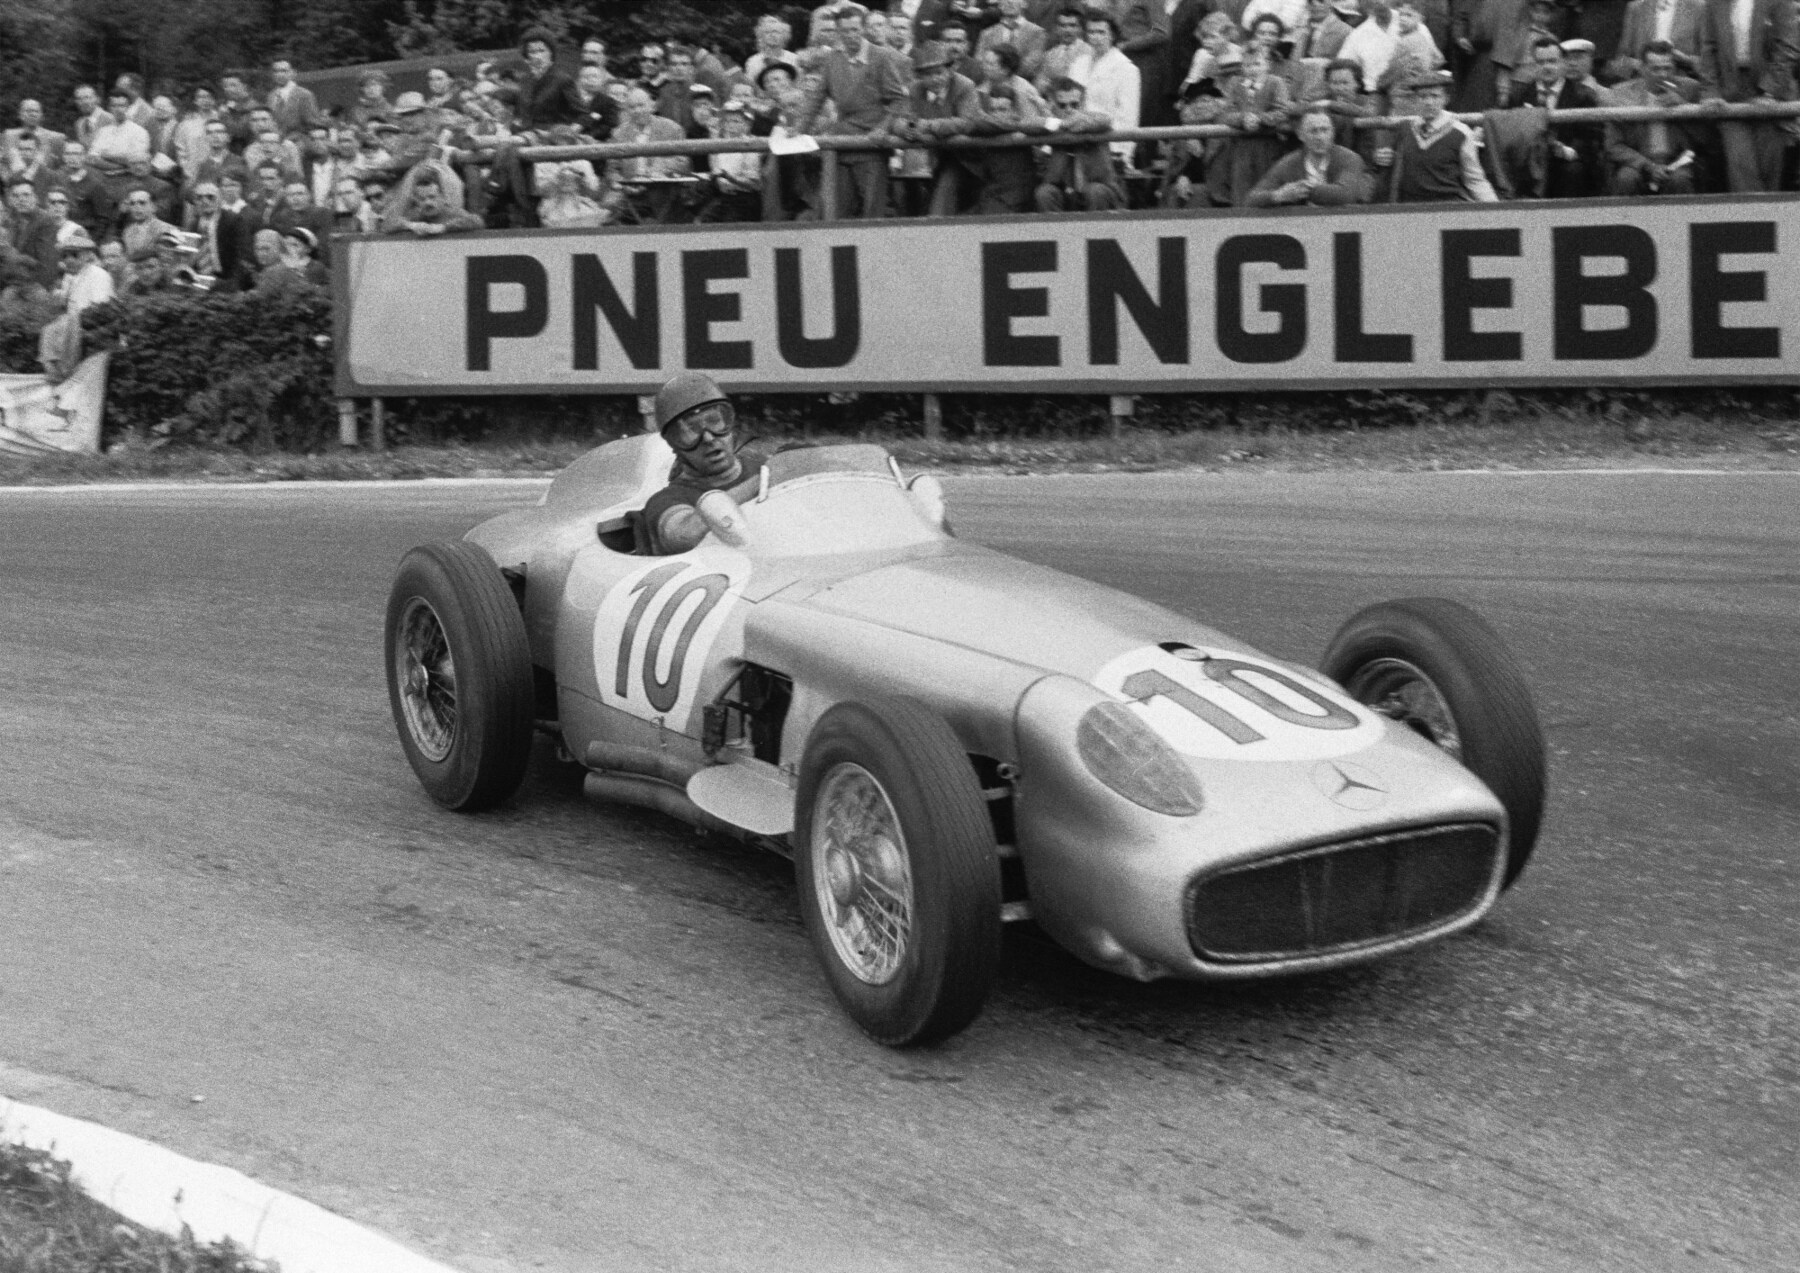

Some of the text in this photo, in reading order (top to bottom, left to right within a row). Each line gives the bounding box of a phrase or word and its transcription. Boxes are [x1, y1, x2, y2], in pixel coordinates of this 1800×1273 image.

[466, 221, 1781, 372] PNEU ENGLEBE
[615, 561, 730, 713] 10
[1121, 658, 1360, 745] 10
